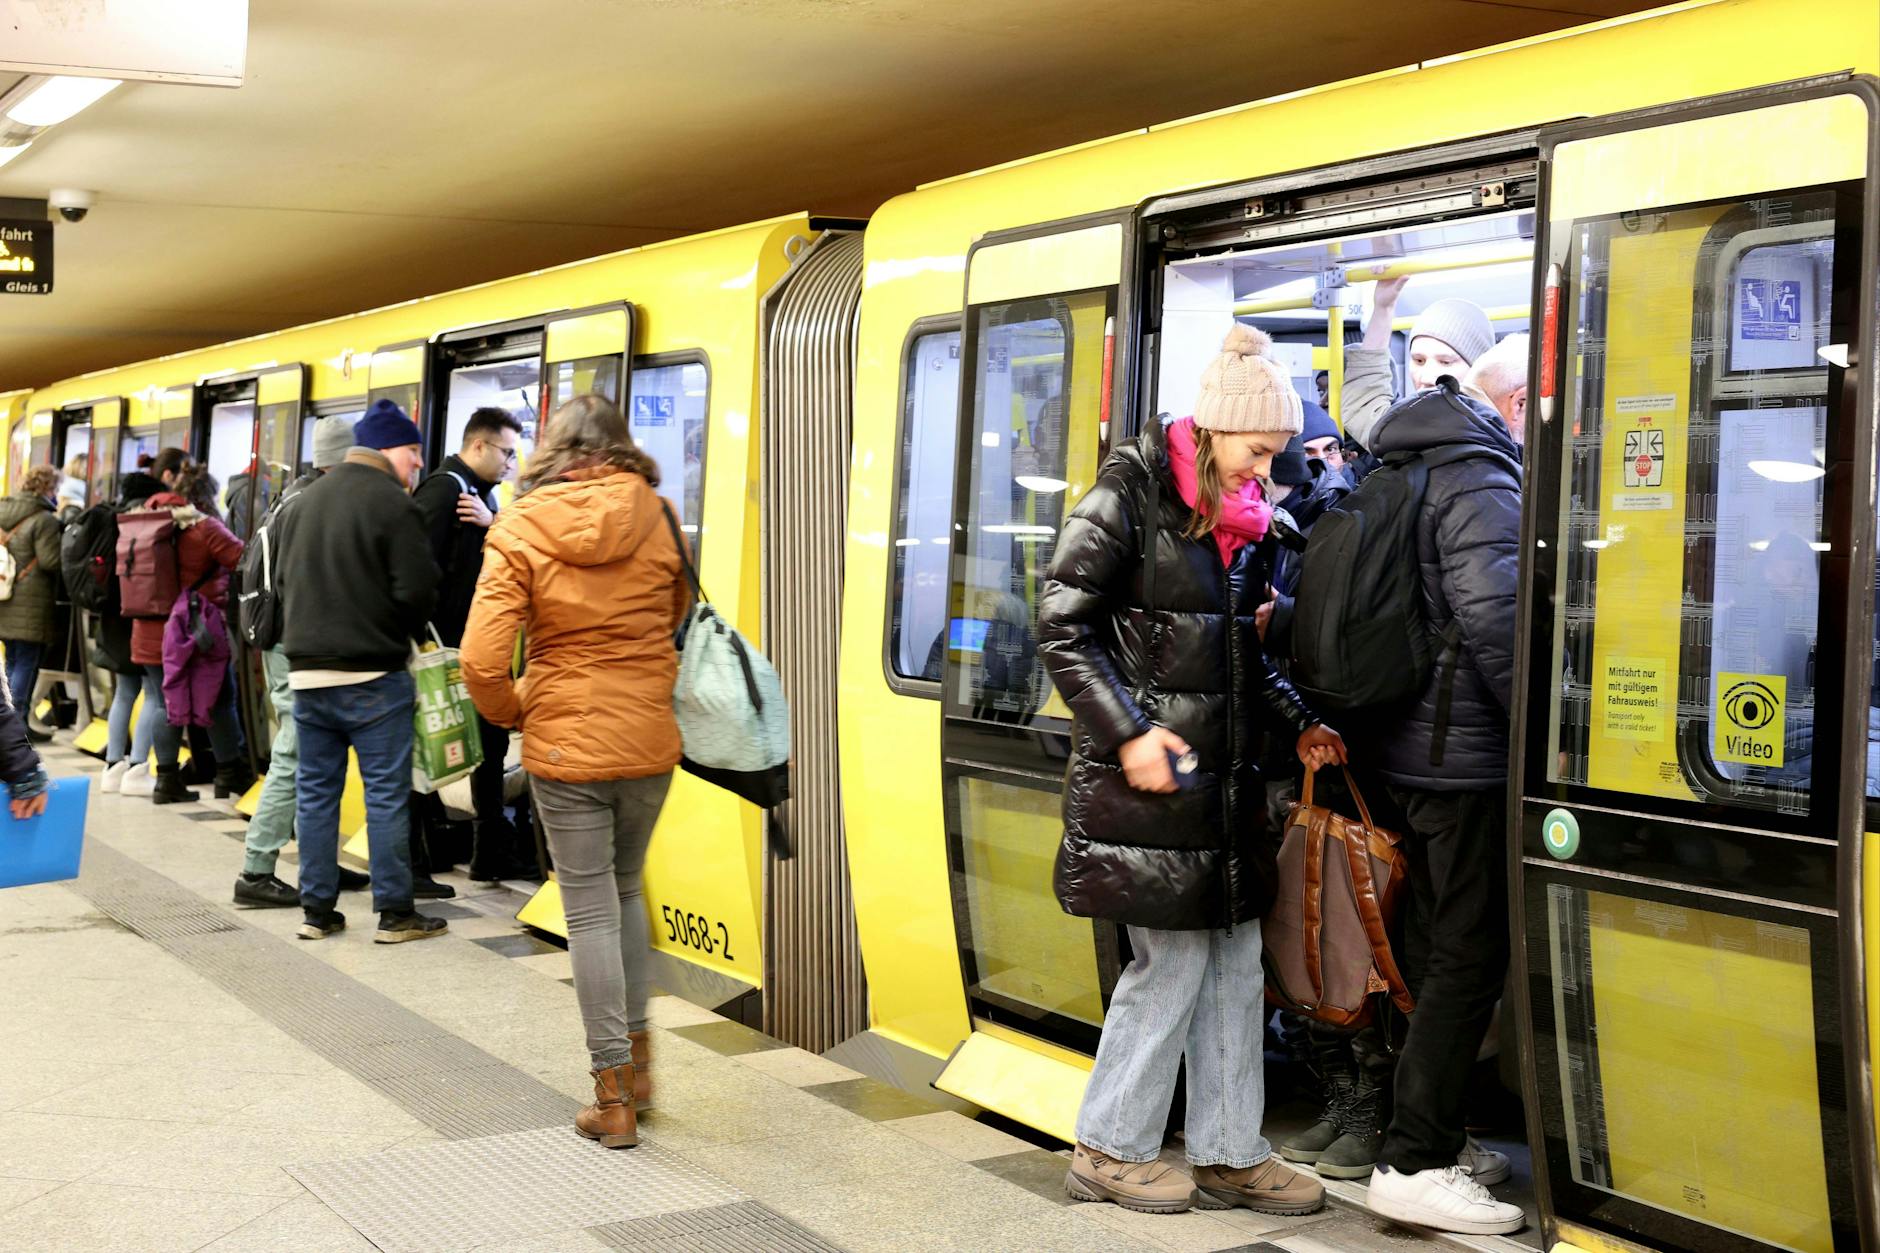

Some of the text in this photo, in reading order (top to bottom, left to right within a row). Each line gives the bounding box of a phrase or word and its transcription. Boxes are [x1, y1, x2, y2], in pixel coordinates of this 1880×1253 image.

[0, 227, 33, 241] fahrt
[6, 281, 48, 293] Gleis 1
[1608, 667, 1656, 678] Mitfahrt nur
[1608, 682, 1658, 694] mit gültigem
[1608, 695, 1658, 707] Fahrausweis!
[425, 704, 464, 733] BAG
[1726, 735, 1773, 759] Video
[662, 904, 735, 961] 5068-2
